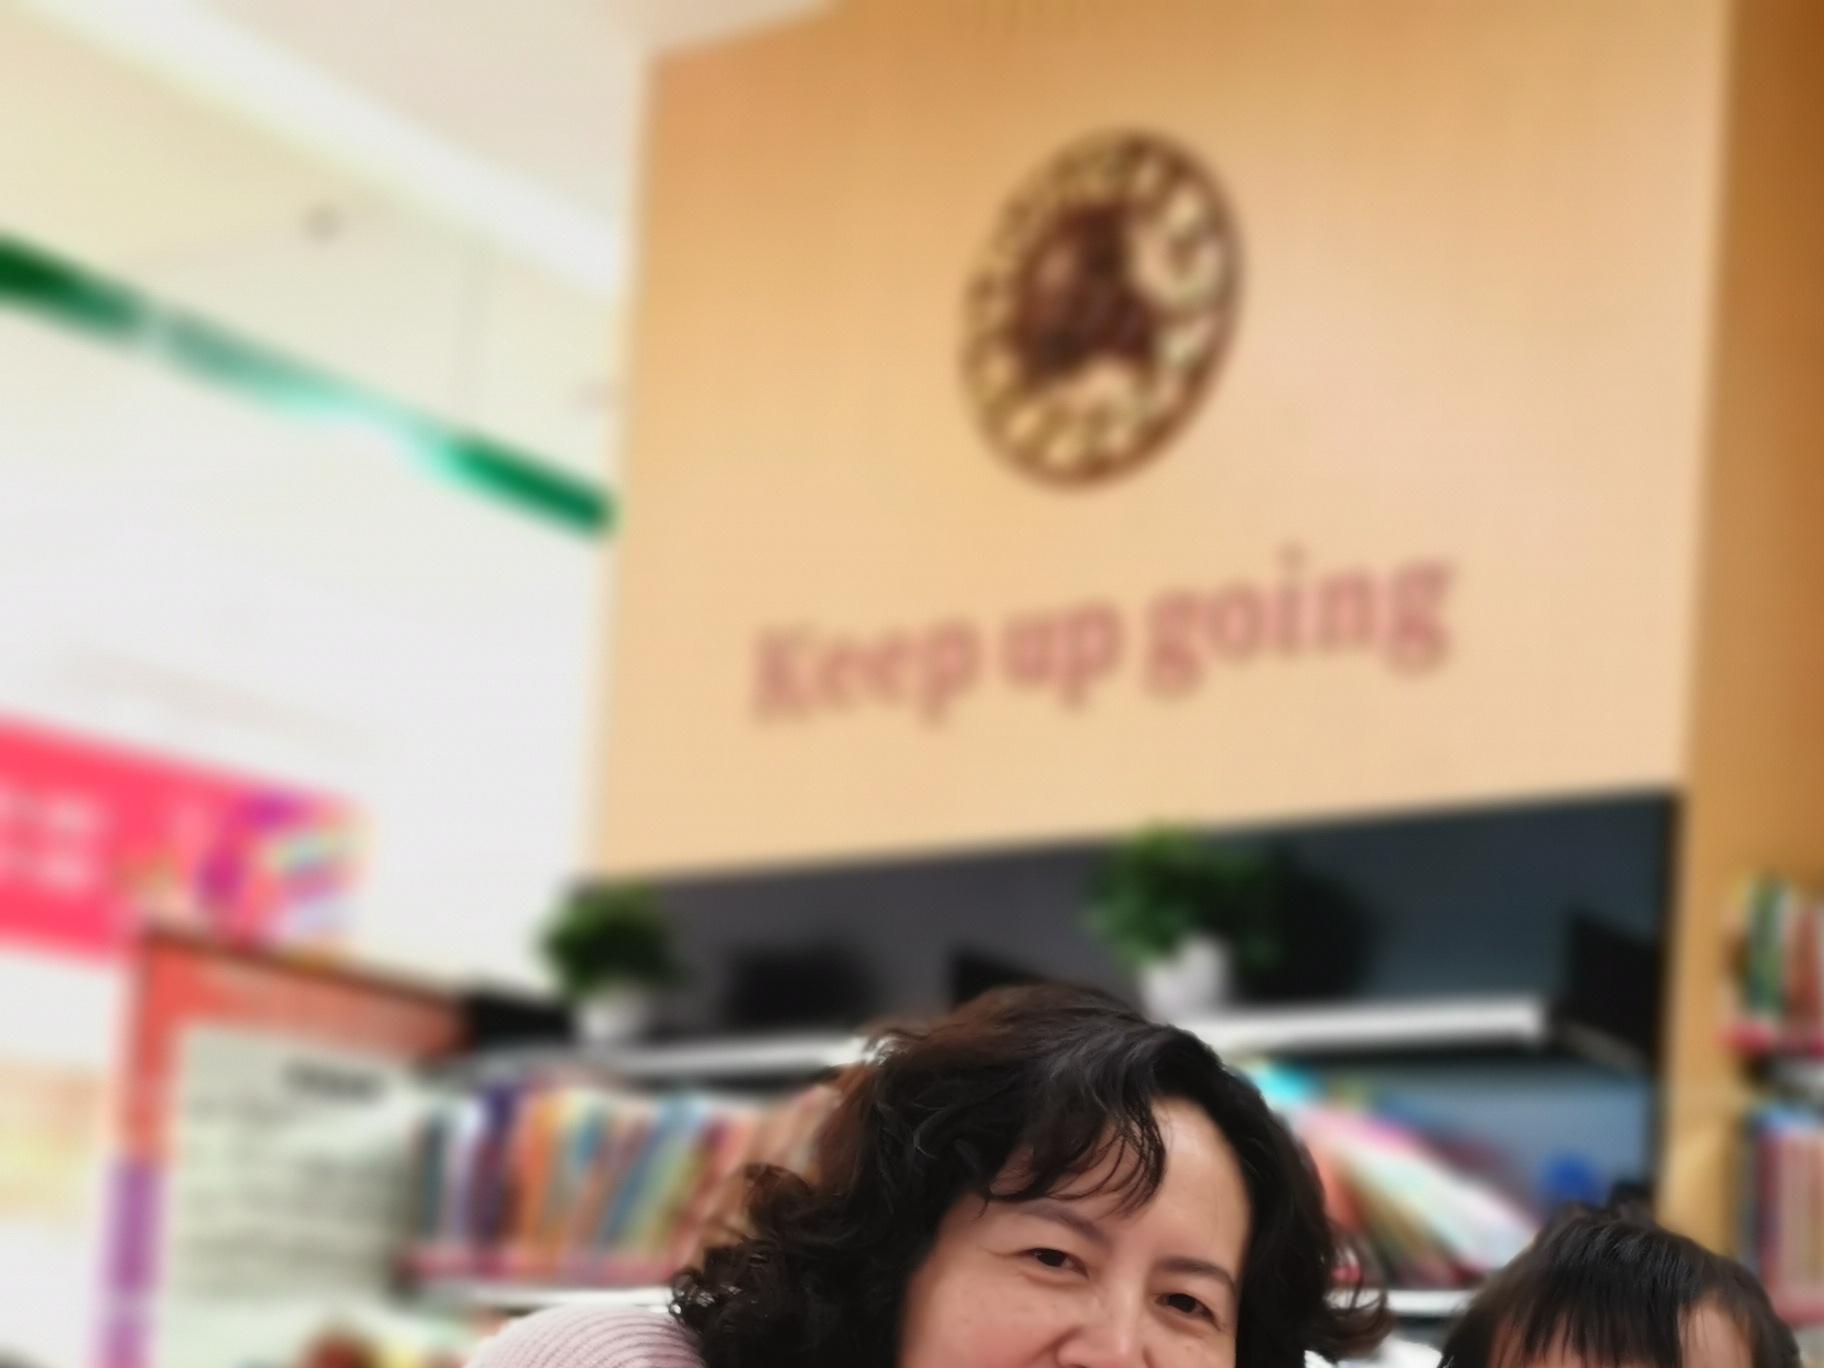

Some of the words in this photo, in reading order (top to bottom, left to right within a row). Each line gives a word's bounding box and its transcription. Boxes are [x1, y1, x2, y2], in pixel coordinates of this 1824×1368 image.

[752, 617, 980, 724] Keep
[1002, 602, 1122, 708] up
[1146, 541, 1455, 699] going
